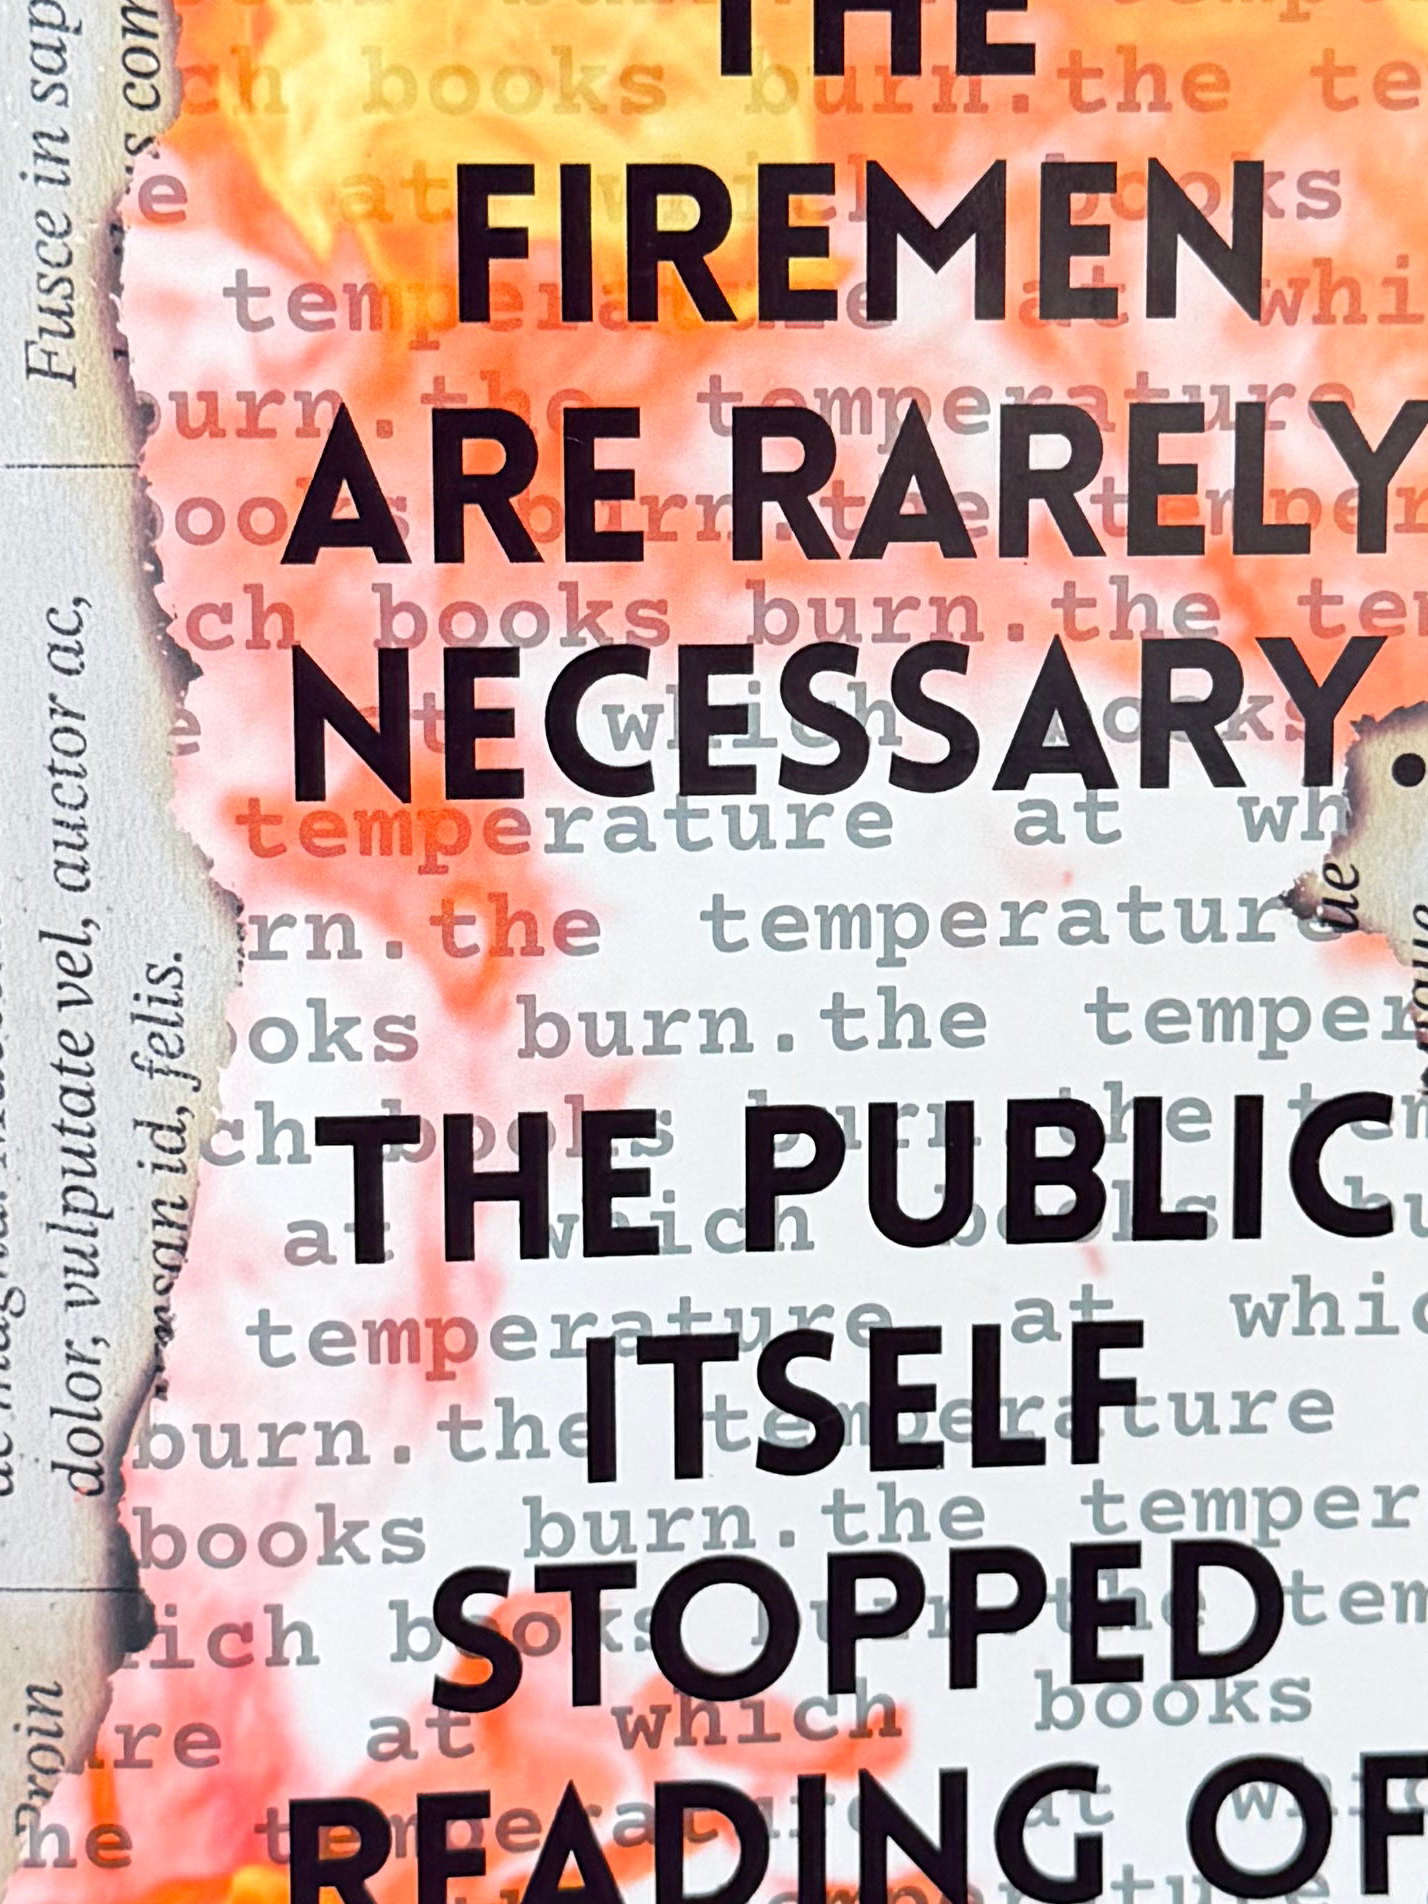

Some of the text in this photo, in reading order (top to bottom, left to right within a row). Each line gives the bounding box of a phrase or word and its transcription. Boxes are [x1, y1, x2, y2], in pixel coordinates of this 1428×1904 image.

[360, 43, 667, 116] books
[743, 43, 1231, 115] burn.the
[19, 145, 73, 186] in
[456, 157, 1265, 323] FIREMEN
[24, 209, 77, 387] Fusce
[279, 401, 644, 565] ARE
[371, 580, 672, 651] books
[745, 574, 1222, 646] burn.the
[291, 633, 1427, 804] NECESSARY.
[234, 794, 894, 876] temperature
[1013, 787, 1123, 846] at
[38, 594, 114, 1497] dolor, vulputate vel, auctor ac,
[129, 951, 202, 1182] id, felis.
[516, 985, 988, 1060] burn.the
[313, 1108, 661, 1265] THE
[744, 1091, 1395, 1253] PUBLIC
[585, 1319, 1145, 1484] ITSELF
[132, 1502, 426, 1572] books
[522, 1487, 986, 1559] burn.the
[432, 1537, 1285, 1713] STOPPED
[365, 1702, 475, 1763] at
[611, 1676, 904, 1751] which
[1033, 1666, 1313, 1732] books
